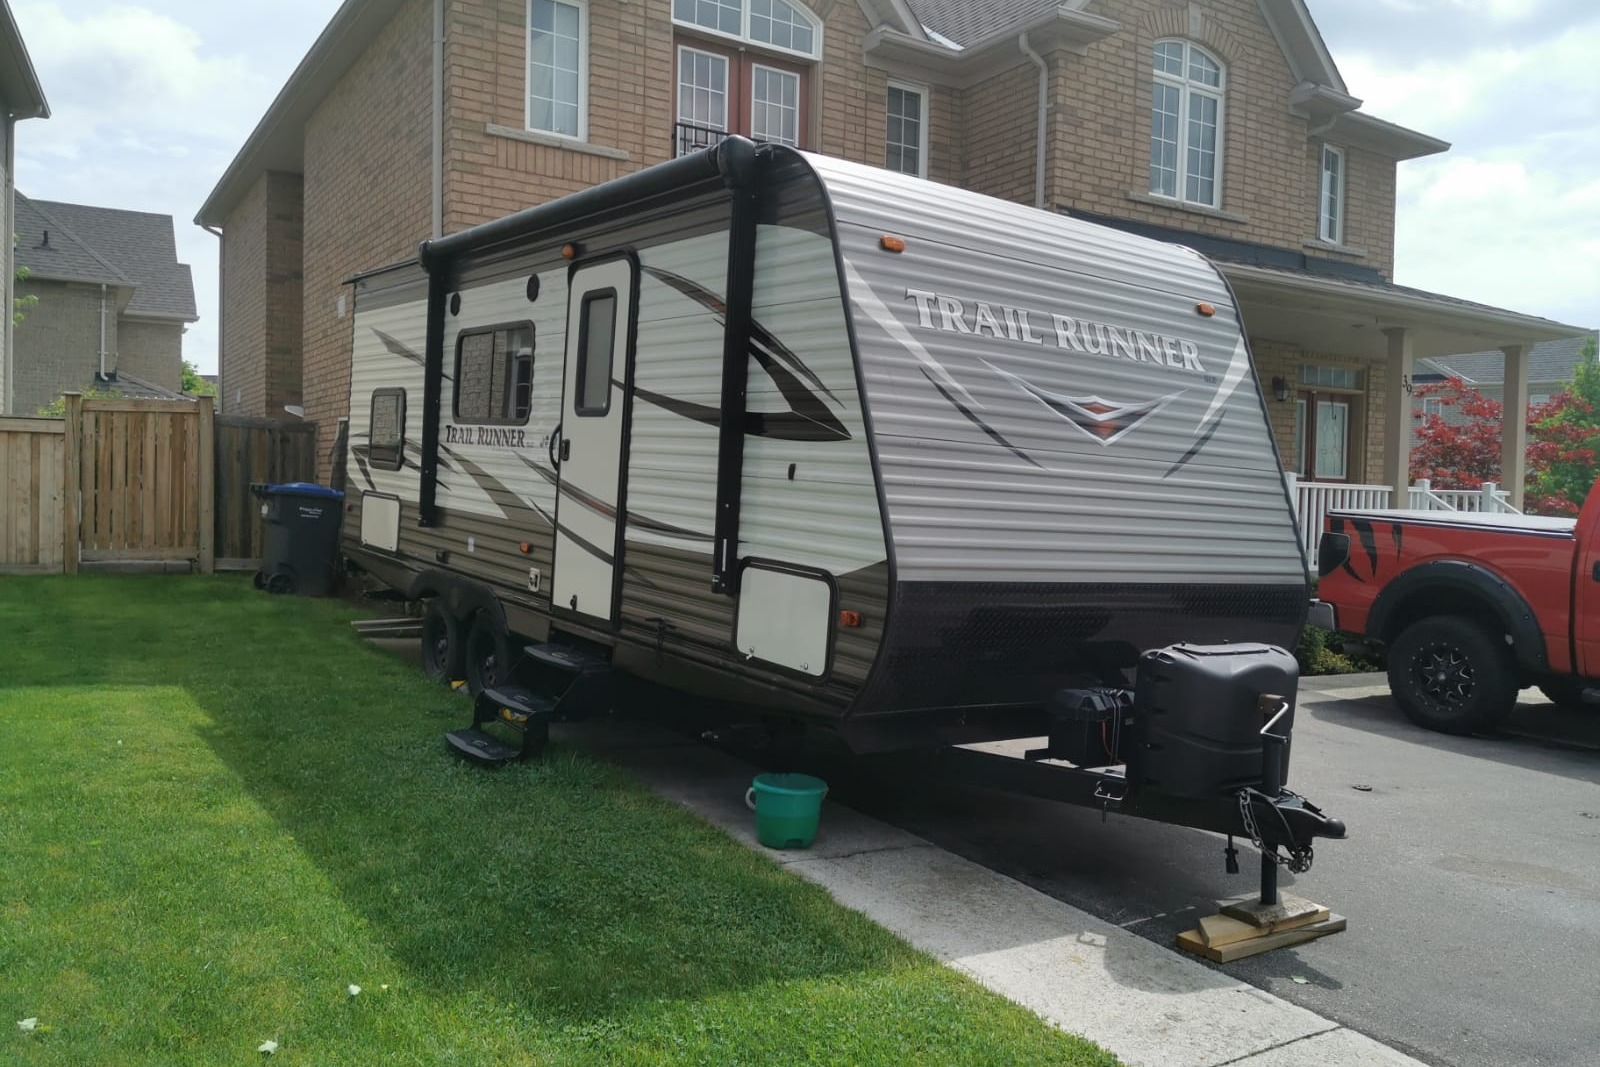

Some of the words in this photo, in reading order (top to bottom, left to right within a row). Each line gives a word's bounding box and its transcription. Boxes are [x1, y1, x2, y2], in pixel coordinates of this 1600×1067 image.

[904, 287, 1044, 345] TRAIL
[1050, 313, 1207, 373] RUNNER
[1402, 374, 1412, 397] 39
[446, 425, 474, 444] TRAIL
[478, 427, 525, 448] RUNNER
